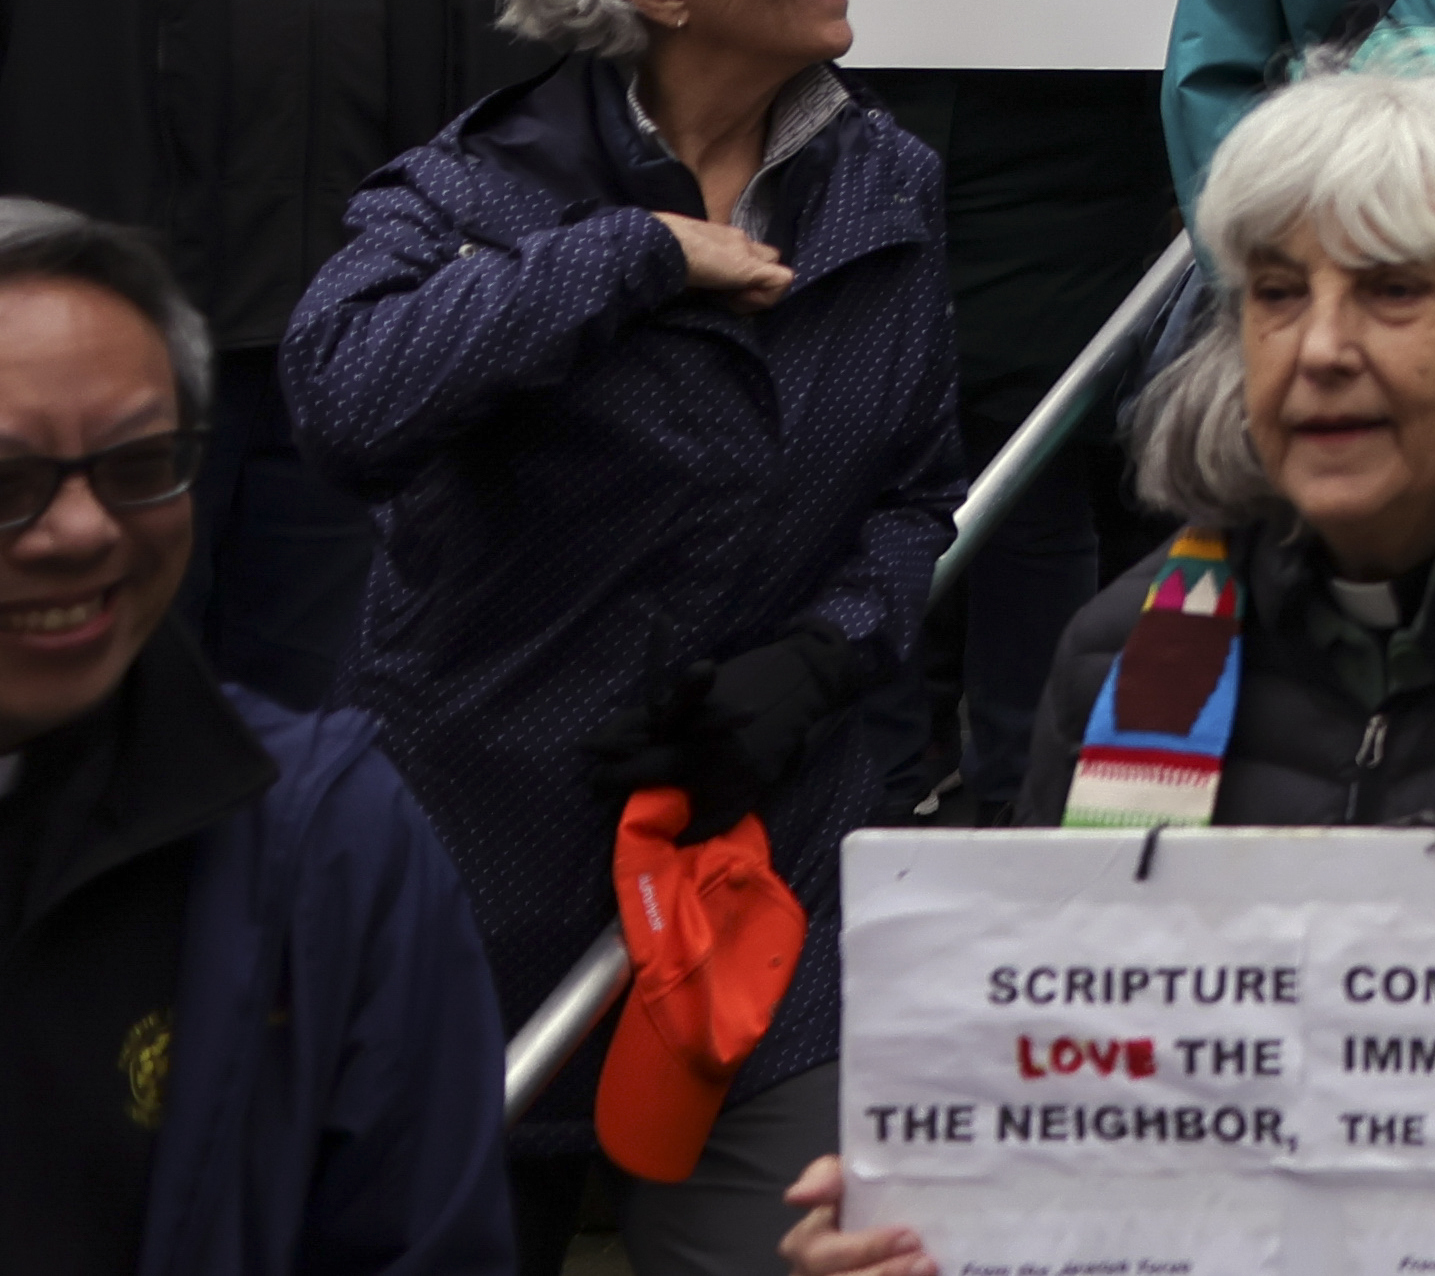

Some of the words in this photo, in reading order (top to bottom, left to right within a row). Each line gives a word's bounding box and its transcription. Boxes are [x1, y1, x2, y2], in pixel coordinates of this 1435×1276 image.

[986, 965, 1299, 1007] SCRIPTURE
[1016, 1035, 1159, 1081] LOVE
[1174, 1038, 1284, 1078] THE
[865, 1105, 977, 1144] THE
[997, 1106, 1300, 1155] NEIGHBOR,
[1340, 1113, 1426, 1147] THE
